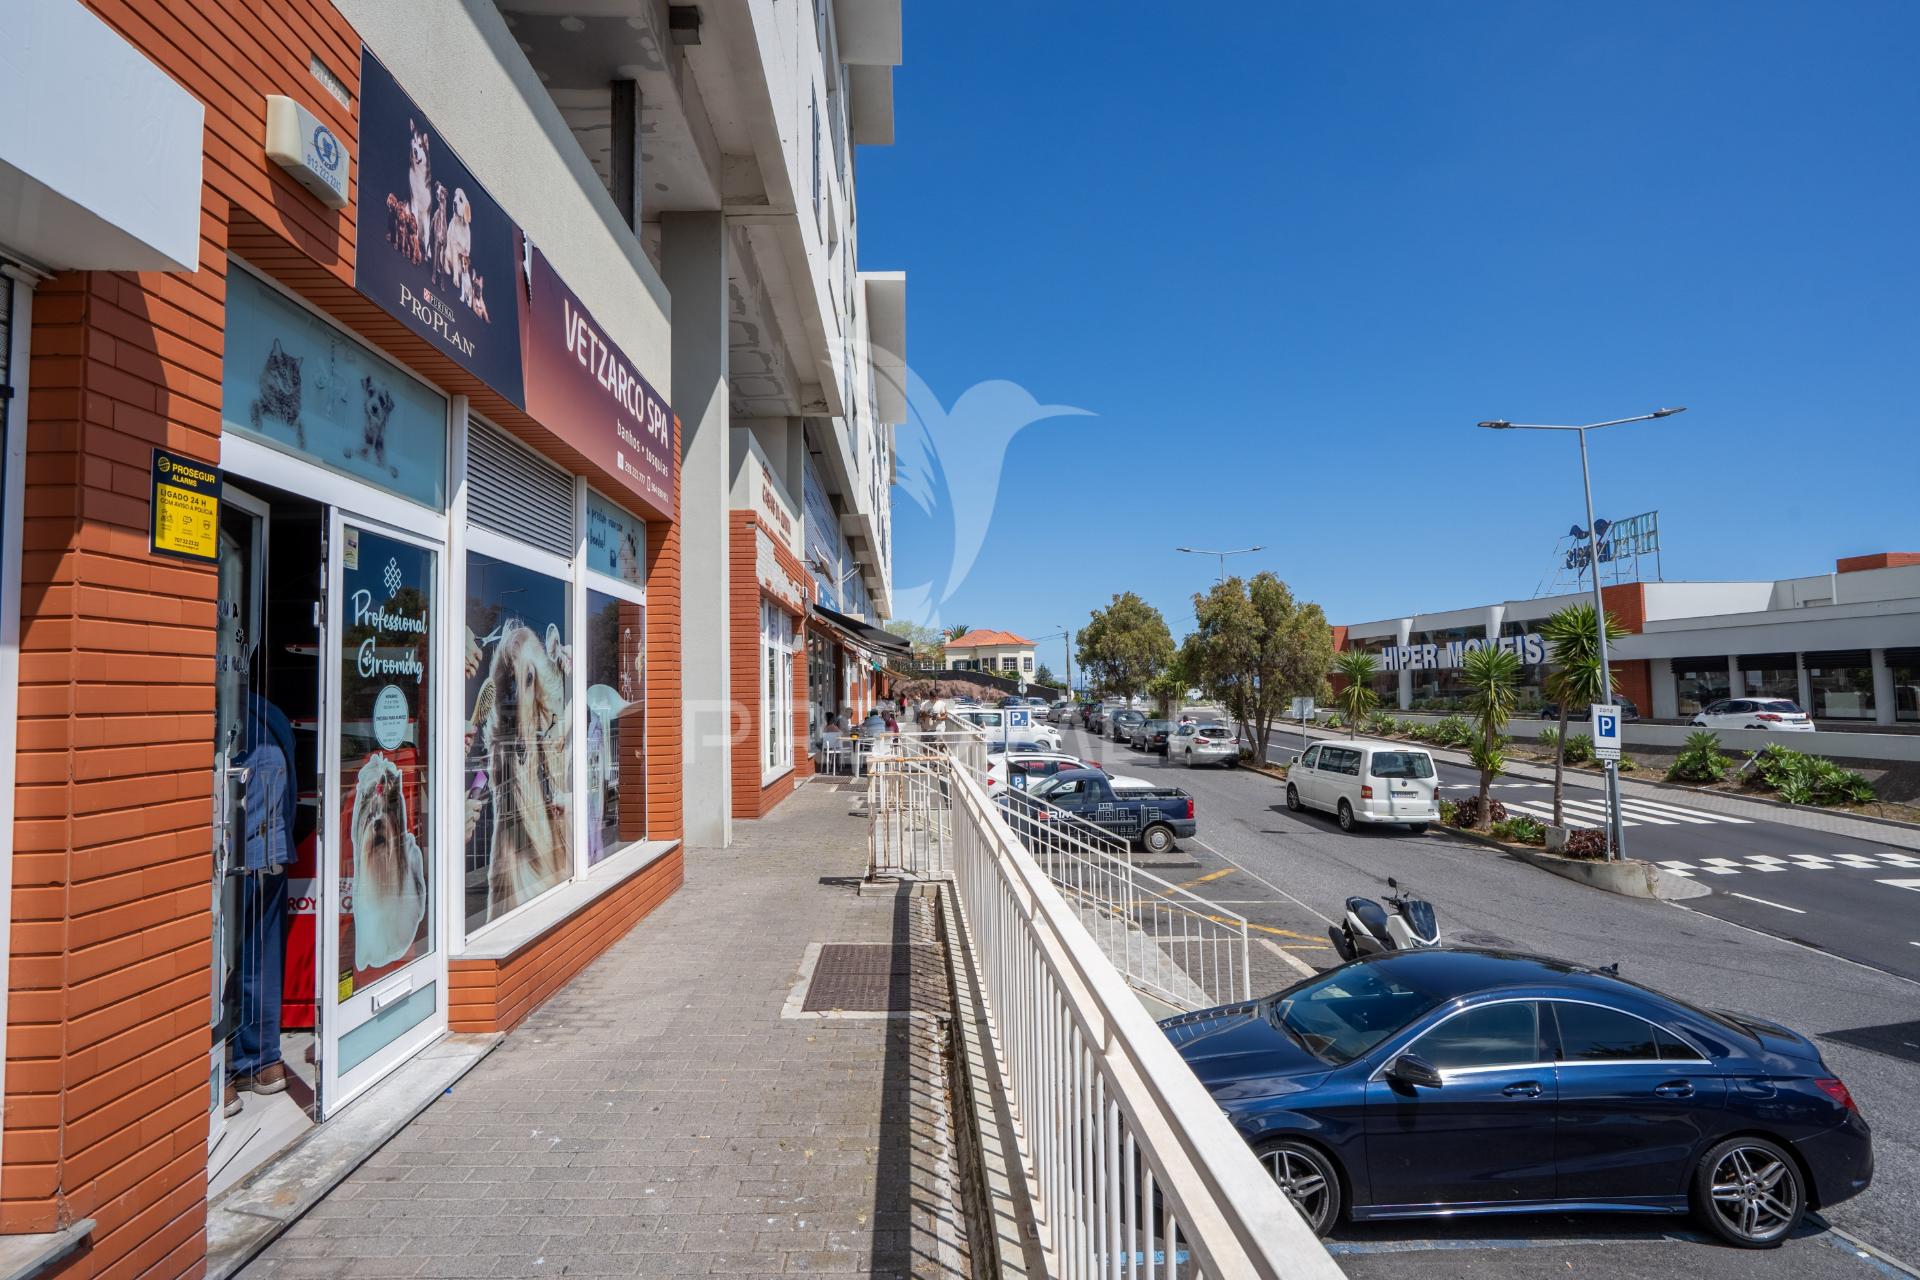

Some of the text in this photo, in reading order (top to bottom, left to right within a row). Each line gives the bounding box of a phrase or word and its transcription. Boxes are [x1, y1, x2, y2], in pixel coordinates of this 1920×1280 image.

[564, 298, 669, 449] VETZARCO SPA
[617, 417, 669, 477] banhos tosquias
[172, 463, 216, 483] PROSEGUR
[172, 474, 197, 487] ALARMS
[160, 488, 207, 507] LIGADO 24 H
[352, 588, 428, 635] Professional
[357, 636, 424, 684] Grooming
[1382, 643, 1438, 670] HIPER
[1601, 717, 1612, 736] P
[288, 896, 316, 911] ROY
